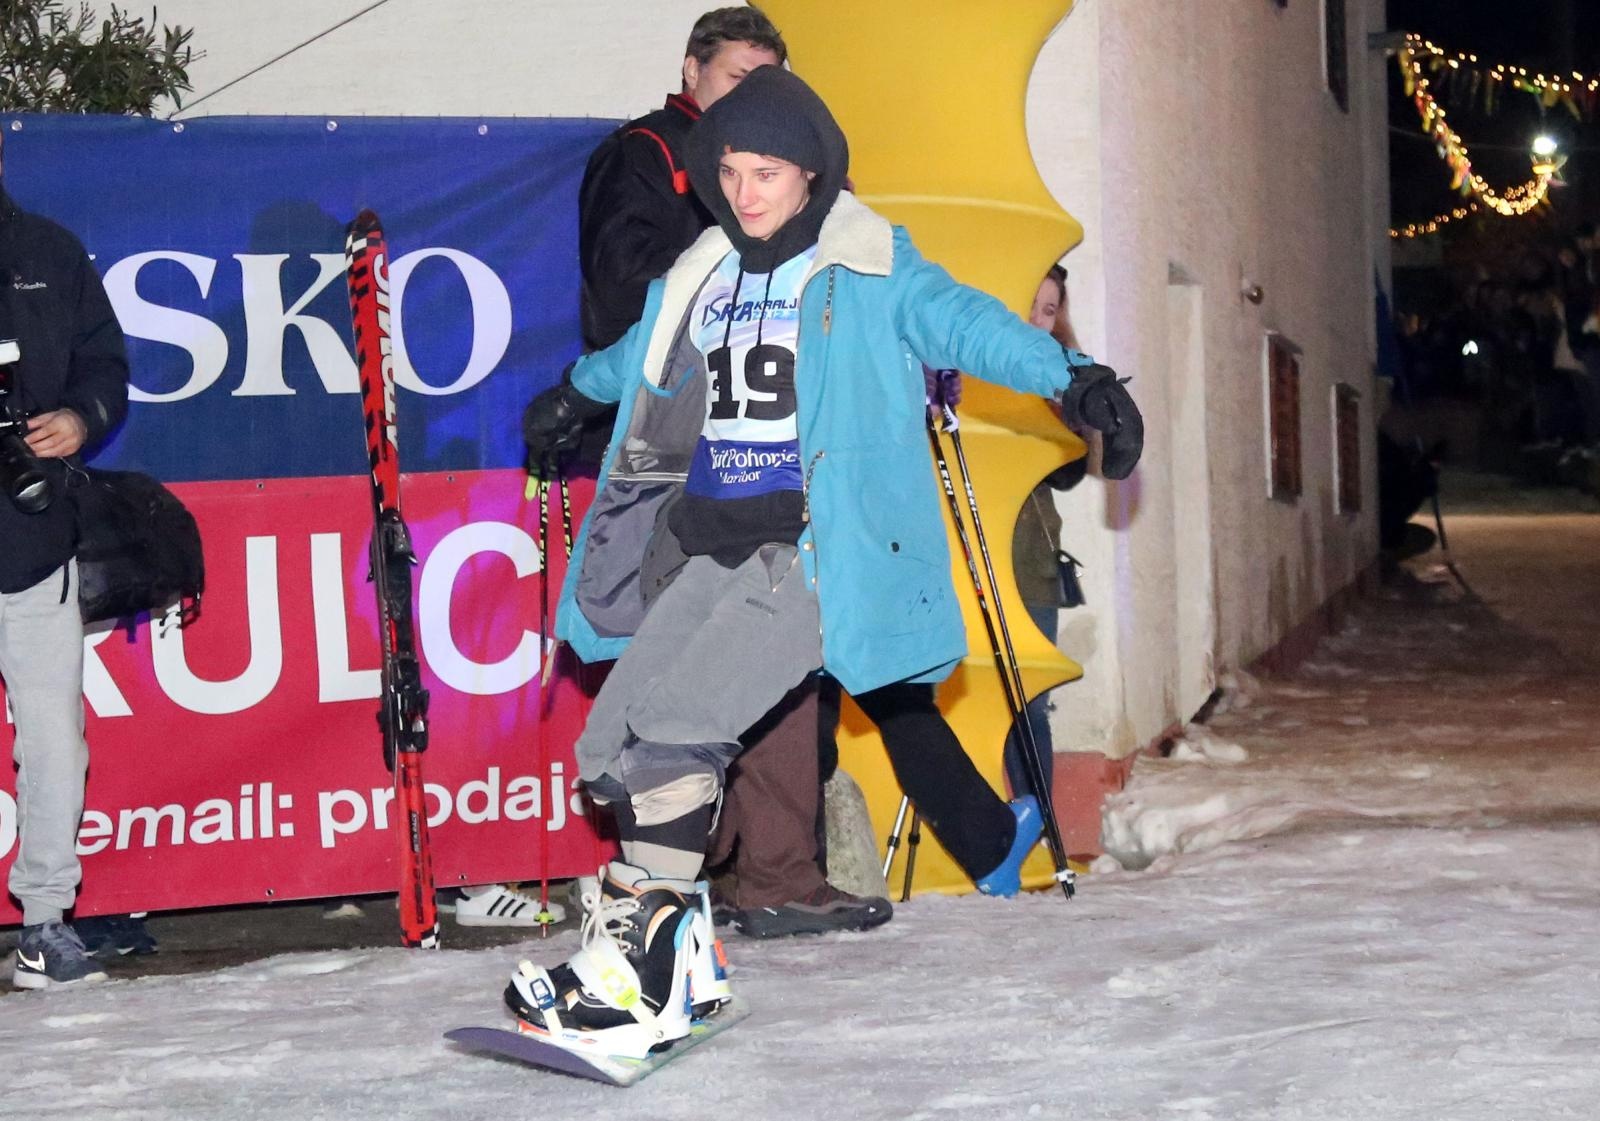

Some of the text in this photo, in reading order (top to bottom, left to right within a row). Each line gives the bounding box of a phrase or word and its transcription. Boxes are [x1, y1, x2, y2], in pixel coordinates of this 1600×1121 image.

[88, 247, 513, 404] SKO
[707, 344, 797, 421] 19
[937, 460, 954, 496] LEKI
[75, 782, 296, 856] email:
